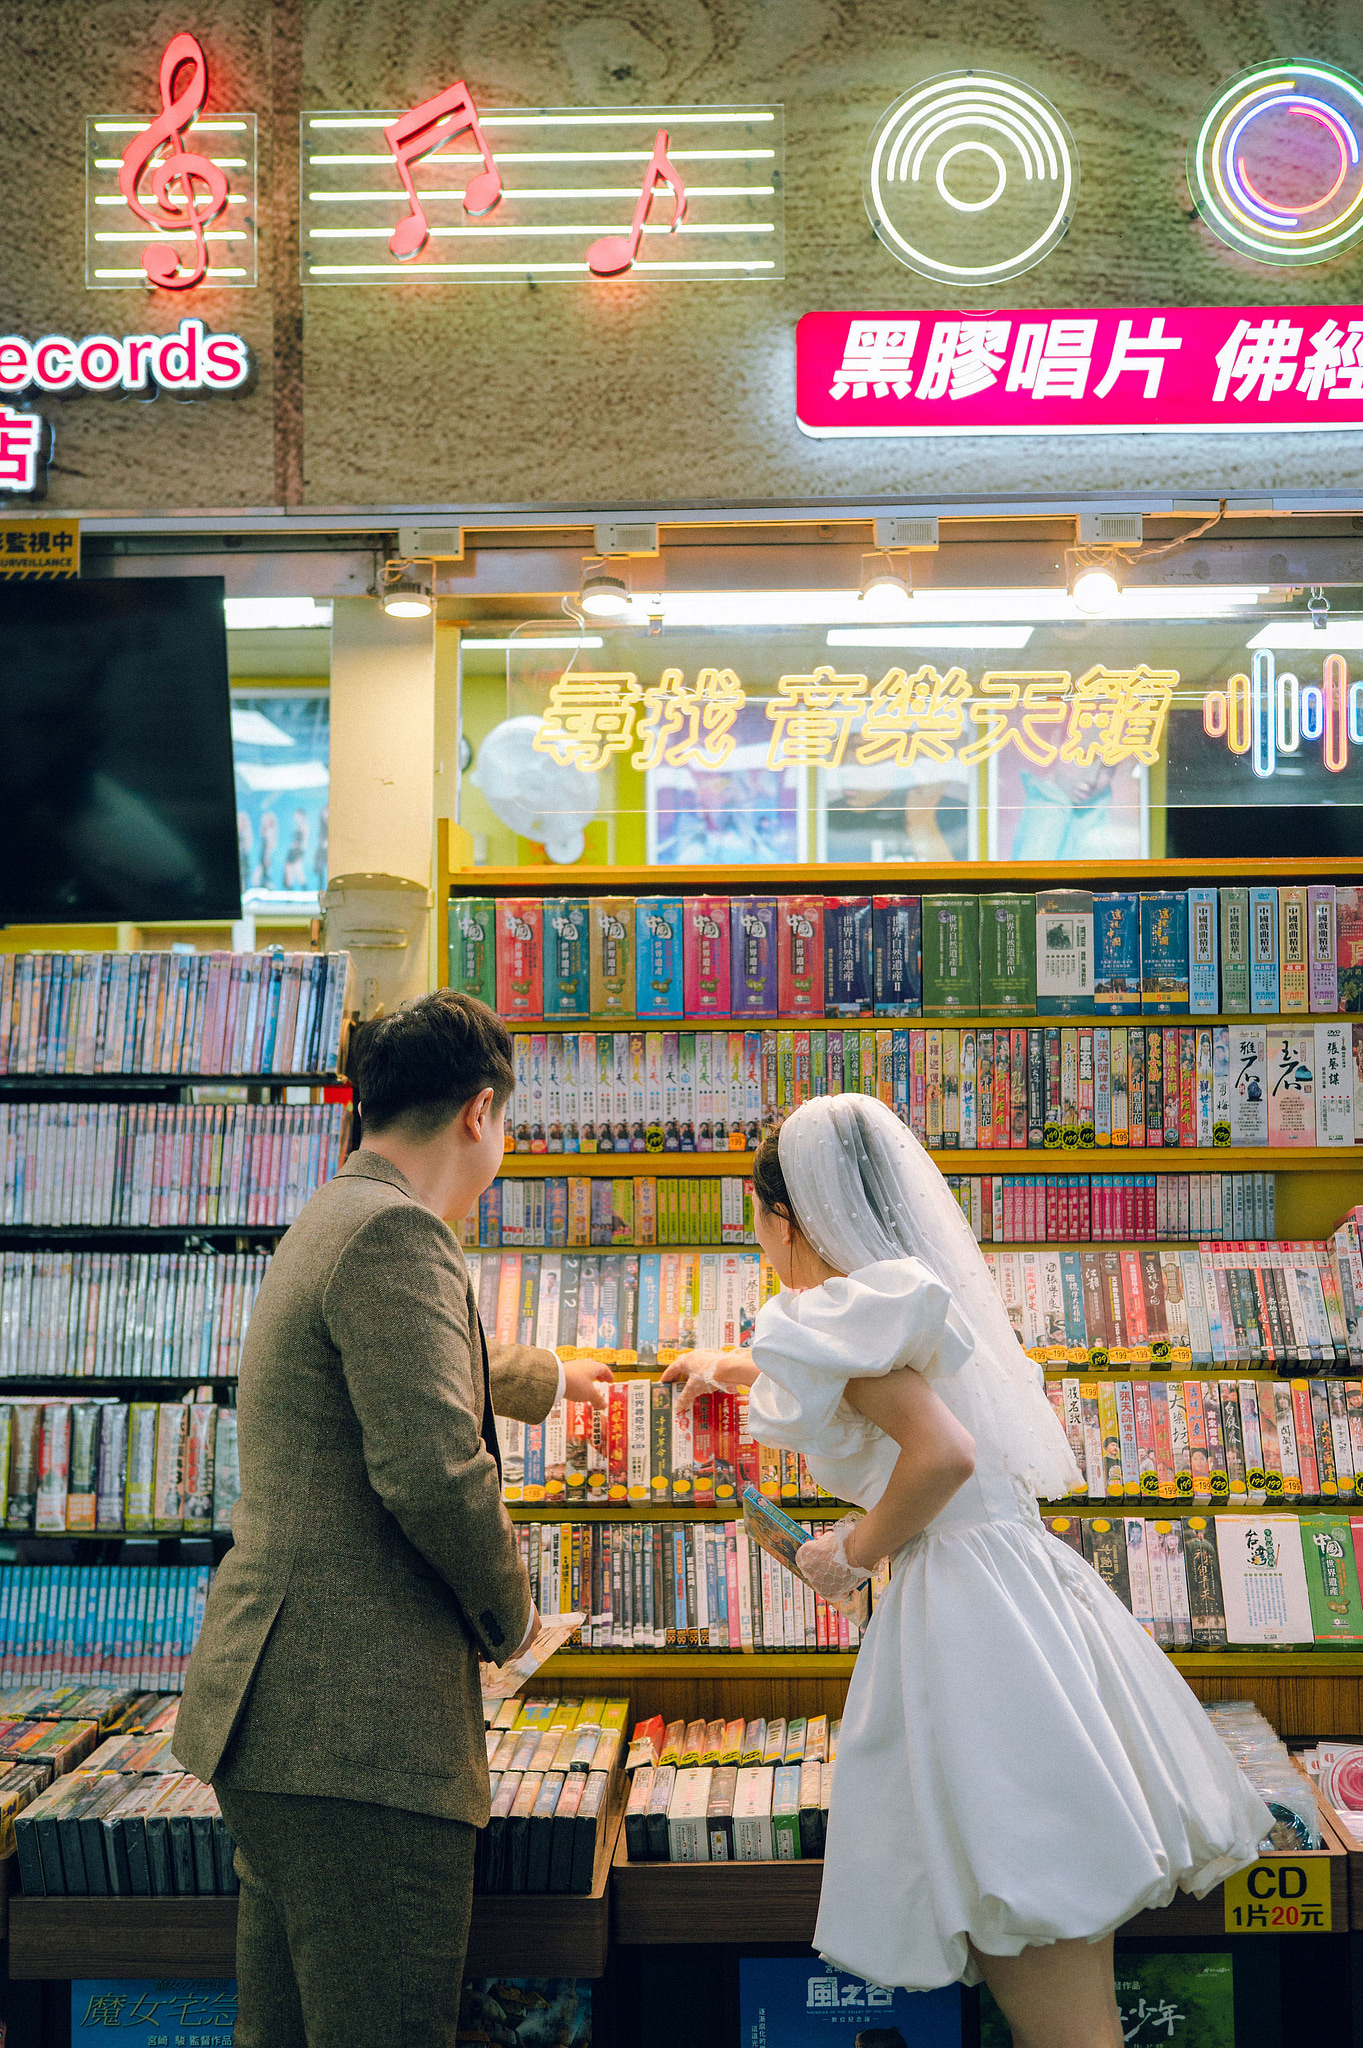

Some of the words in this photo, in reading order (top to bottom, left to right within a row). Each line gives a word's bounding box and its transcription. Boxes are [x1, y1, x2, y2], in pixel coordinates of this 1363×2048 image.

[829, 317, 1183, 401] 黑膠唱片
[1210, 318, 1363, 401] 佛經
[0, 531, 73, 553] 監視中
[533, 668, 745, 772] 尋找
[766, 665, 1180, 770] 音樂天籟
[1097, 1039, 1109, 1092] 張天師傳奇
[1116, 1133, 1127, 1141] 199
[1034, 1352, 1046, 1360] 199
[1054, 1350, 1065, 1358] 199
[1115, 1351, 1127, 1359] 199
[1136, 1351, 1148, 1359] 199
[1085, 1388, 1097, 1396] 199
[1120, 1391, 1134, 1442] 張天師傳奇
[1164, 1487, 1176, 1495] 199
[1199, 1482, 1210, 1490] 199
[1212, 1480, 1226, 1489] 199
[1289, 1482, 1300, 1490] 199
[1313, 1533, 1344, 1558] 中國
[1325, 1559, 1339, 1596] 世界遺產
[1247, 1867, 1307, 1899] CD
[1233, 1904, 1324, 1927] 1片20元
[806, 1977, 895, 2007] 風之谷
[79, 1992, 238, 2027] 魔女宅急
[190, 2035, 232, 2047] 監督作品
